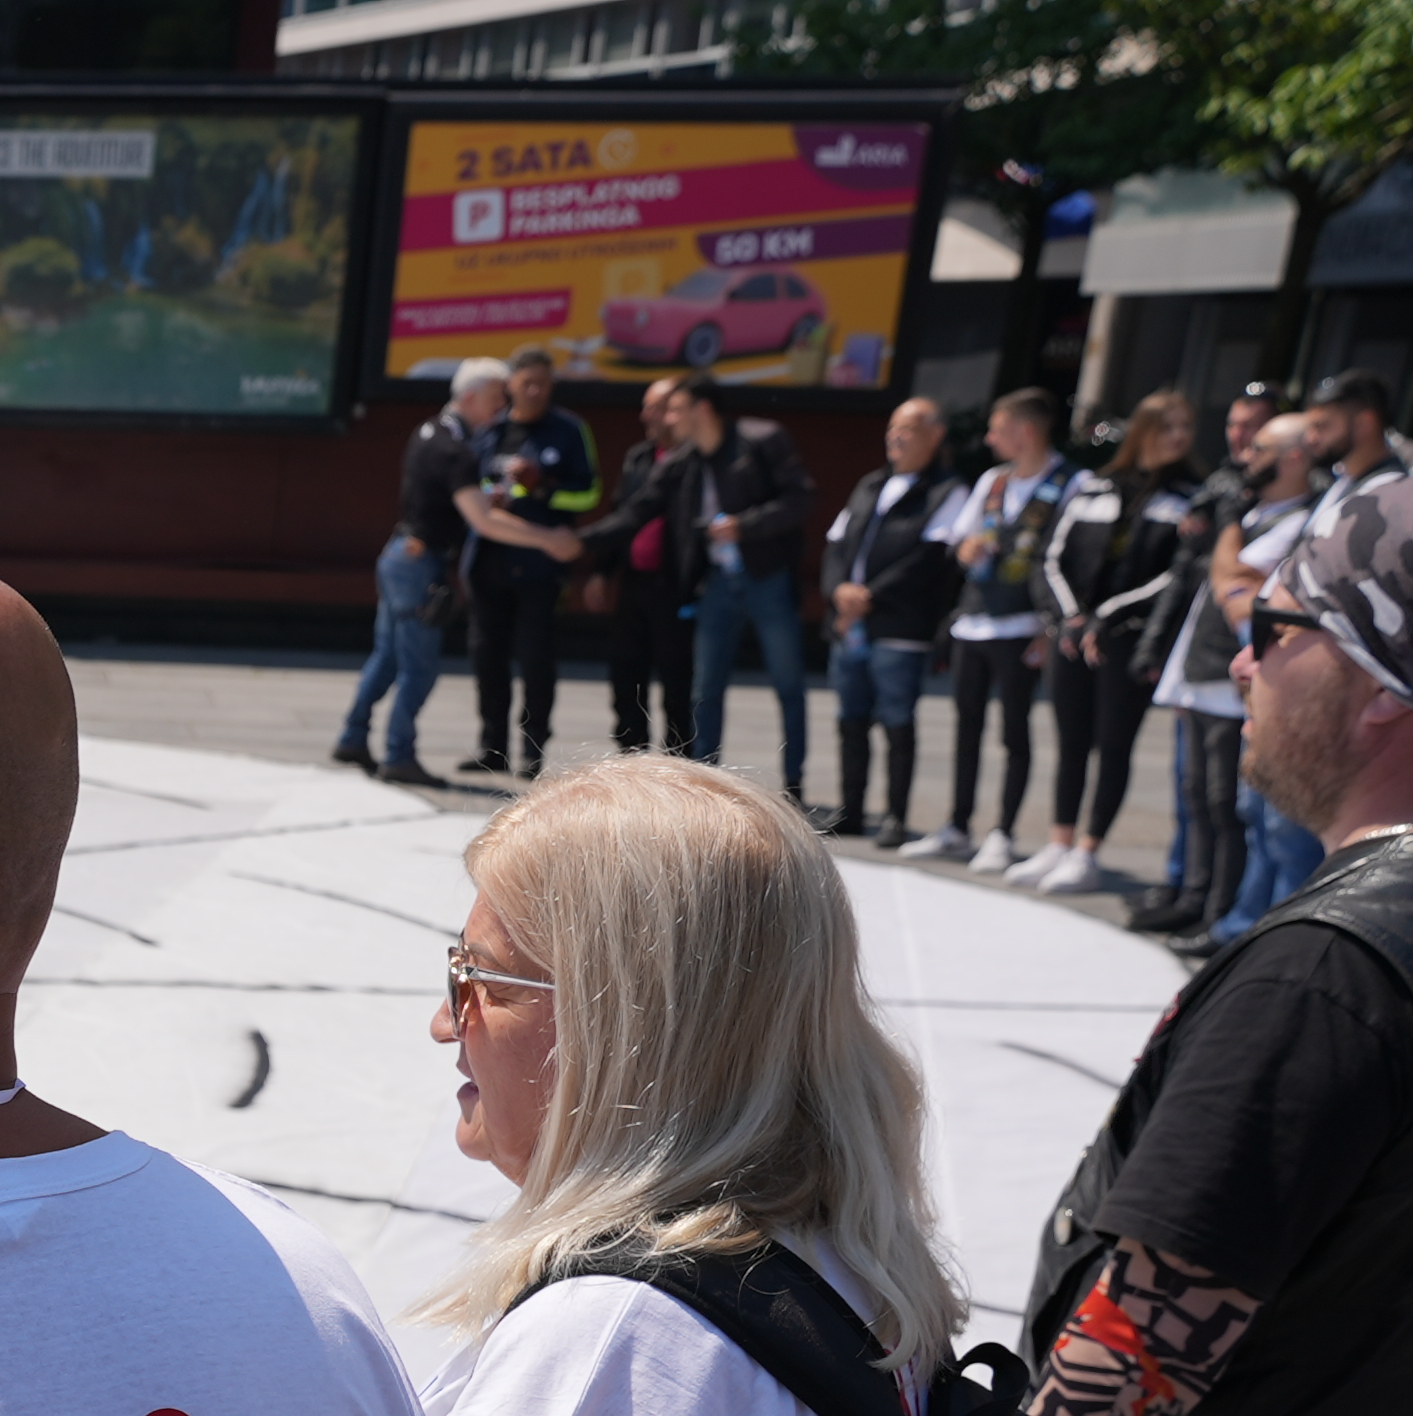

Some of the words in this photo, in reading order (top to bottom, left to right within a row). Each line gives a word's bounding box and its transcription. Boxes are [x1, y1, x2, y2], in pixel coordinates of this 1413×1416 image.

[457, 149, 479, 181] 2
[491, 139, 592, 178] SATA
[510, 174, 681, 210] BESPLATNOG
[509, 203, 641, 237] PARKINGA
[715, 232, 760, 265] 50
[763, 227, 815, 261] KM
